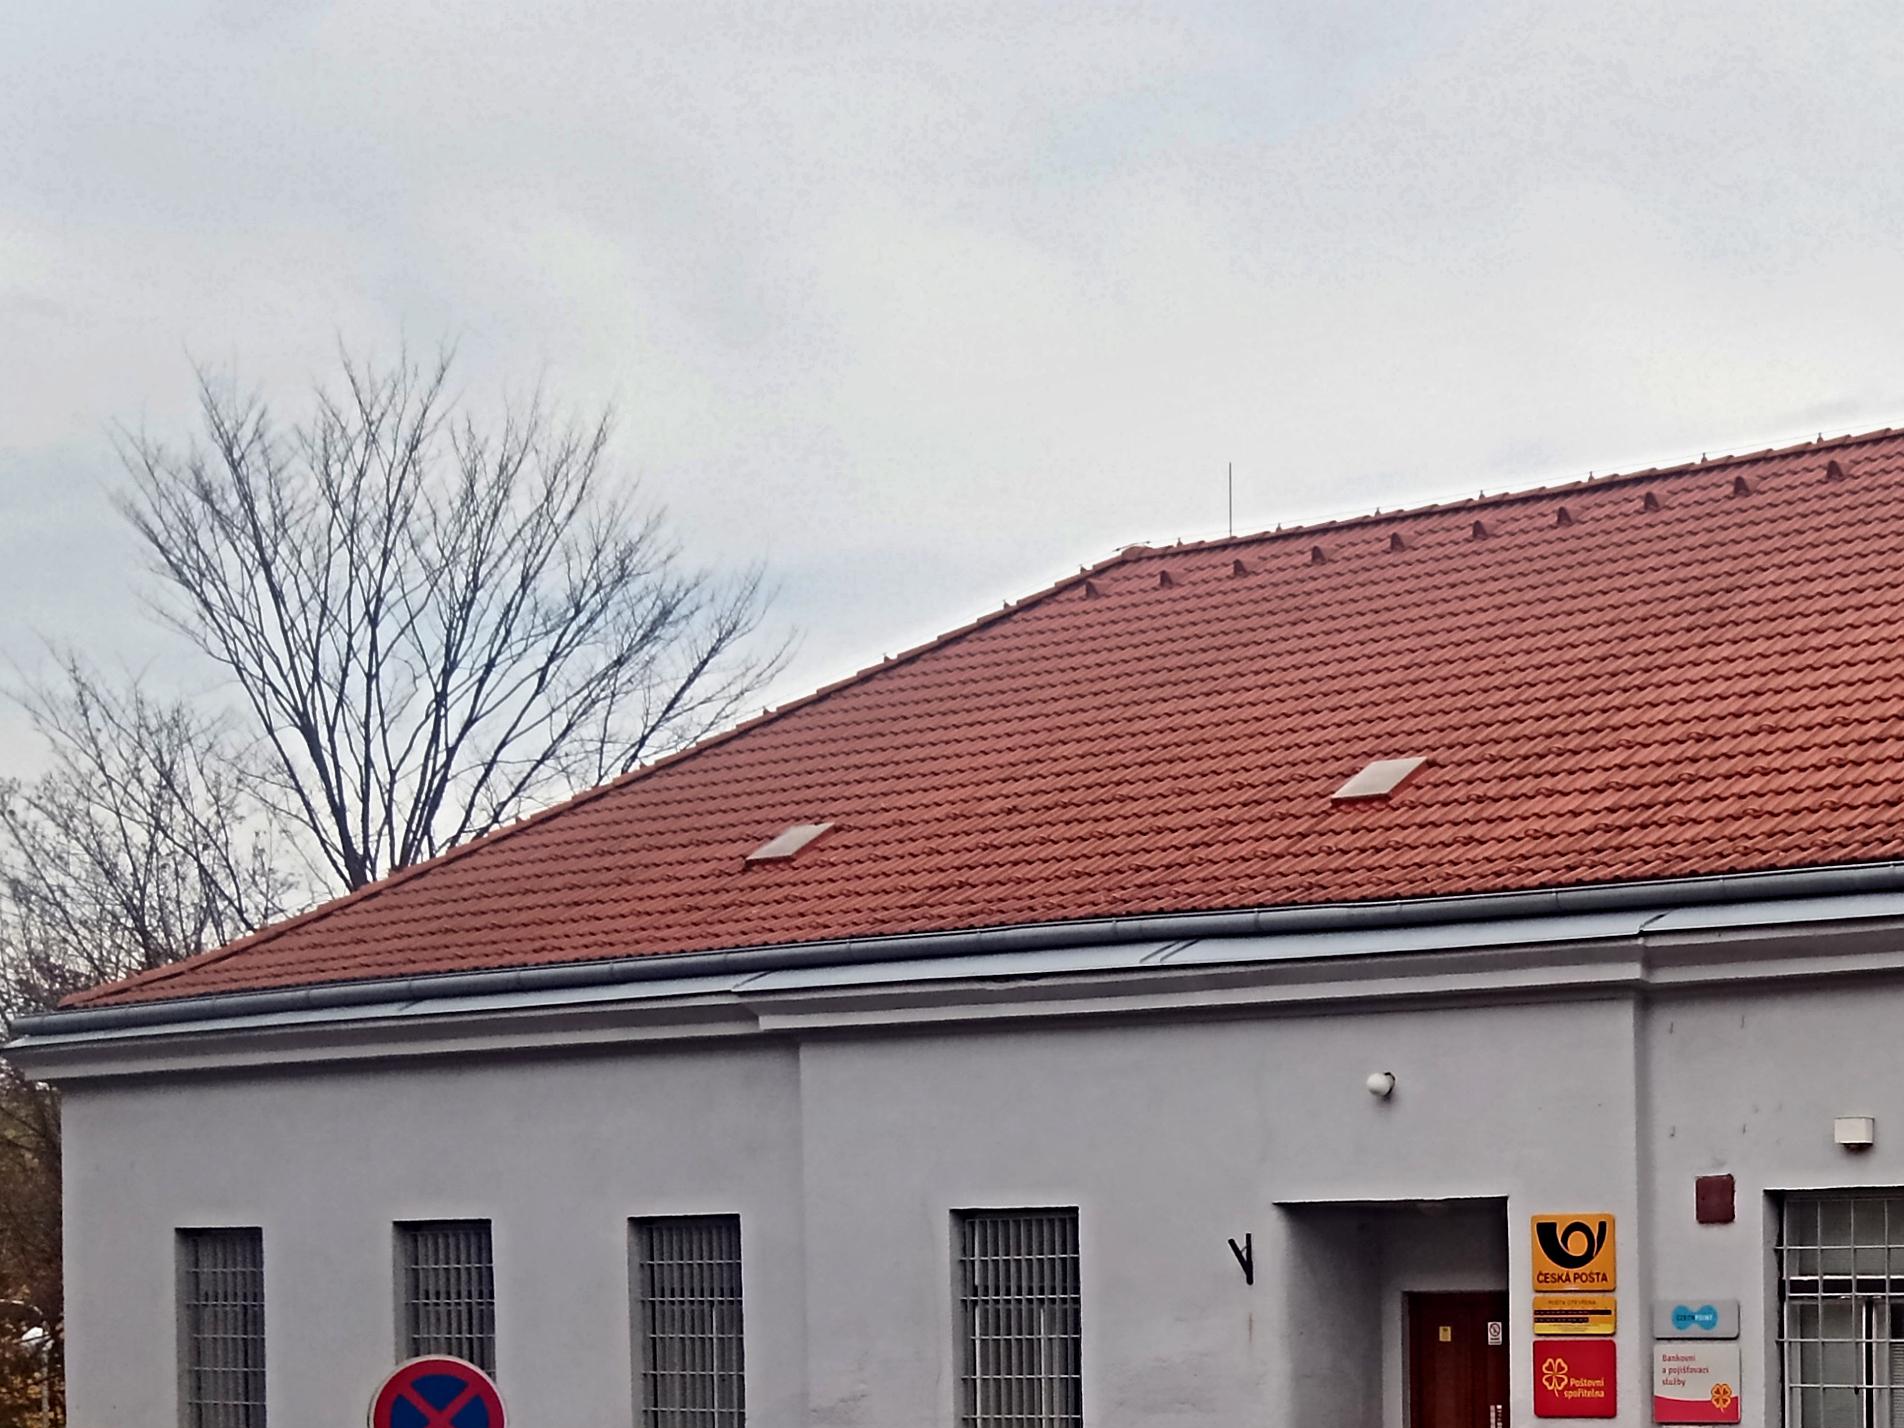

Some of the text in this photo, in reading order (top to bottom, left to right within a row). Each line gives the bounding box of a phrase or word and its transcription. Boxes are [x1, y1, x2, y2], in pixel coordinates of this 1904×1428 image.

[1536, 1270, 1608, 1284] ČESKÁ POŠTA
[1569, 1377, 1605, 1388] Poštovní
